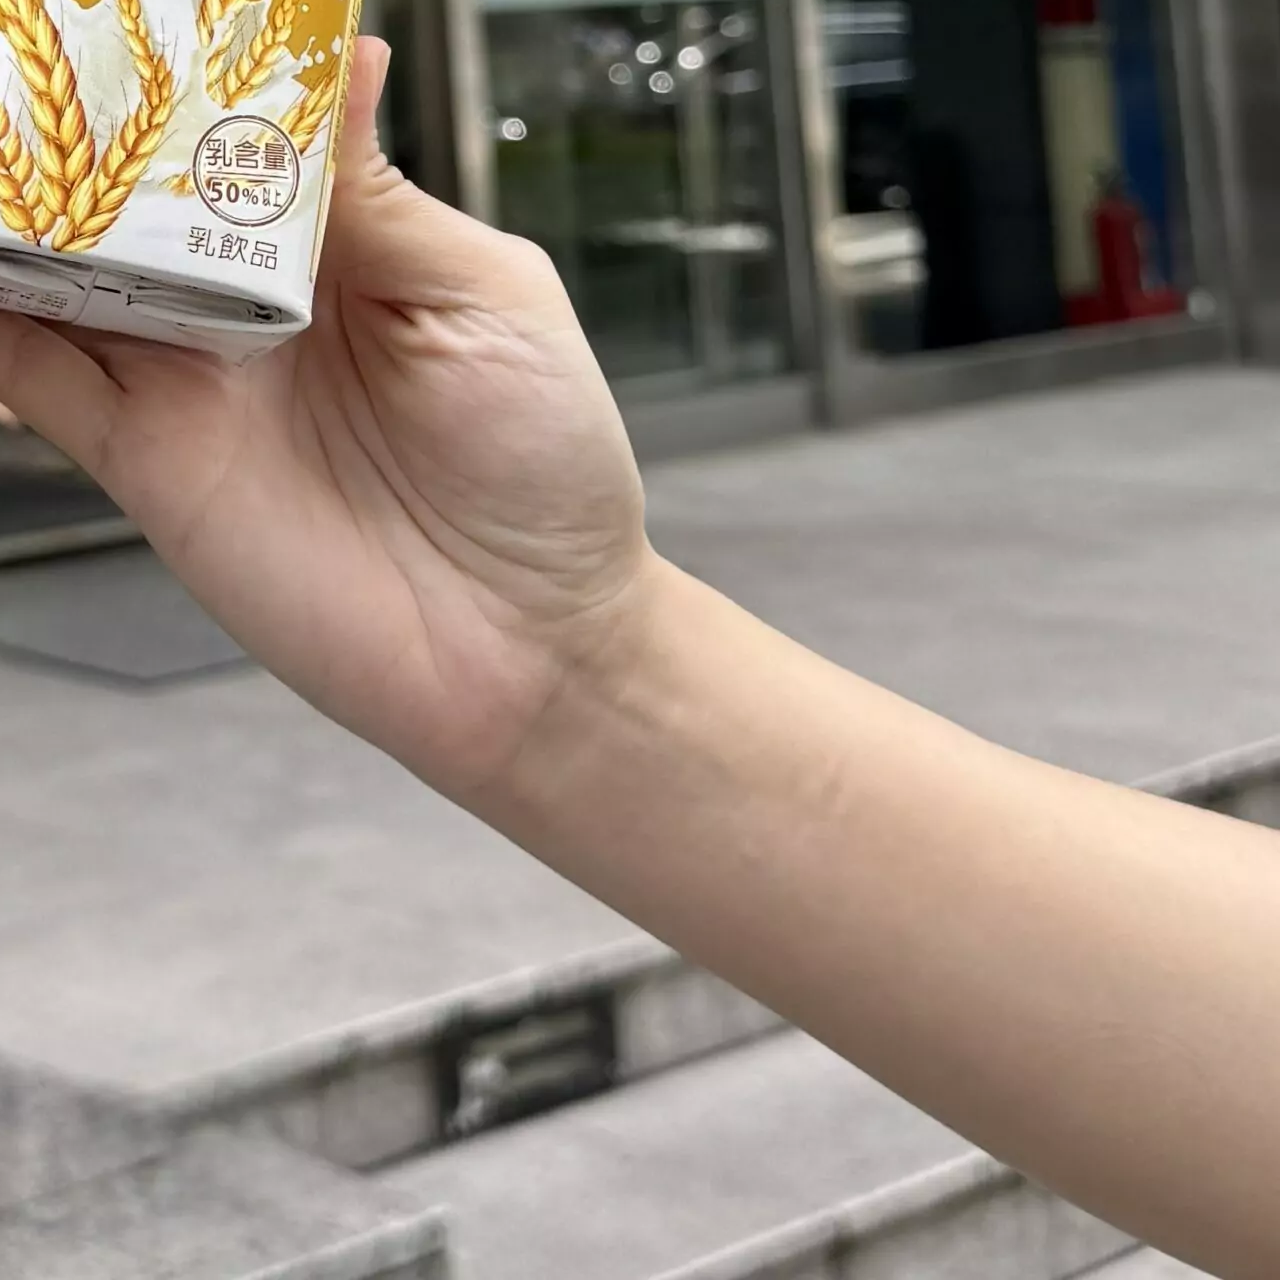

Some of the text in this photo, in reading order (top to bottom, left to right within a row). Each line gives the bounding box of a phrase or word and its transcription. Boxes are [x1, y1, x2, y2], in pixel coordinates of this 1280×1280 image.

[205, 138, 289, 171] 乳含量
[187, 225, 278, 270] 乳飲品
